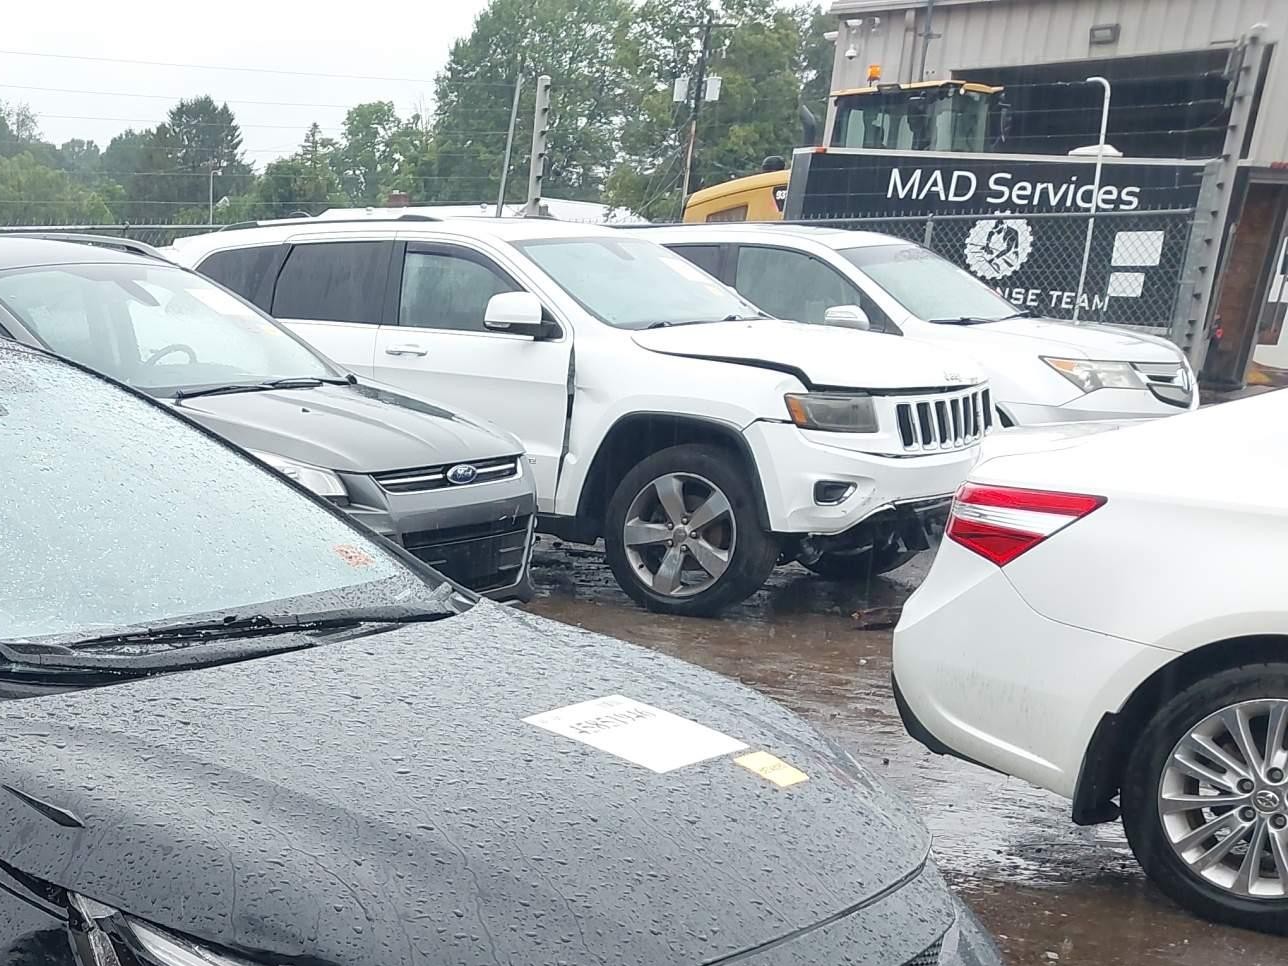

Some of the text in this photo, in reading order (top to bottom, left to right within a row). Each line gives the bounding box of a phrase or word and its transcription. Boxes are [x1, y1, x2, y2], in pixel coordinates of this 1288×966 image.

[886, 167, 1142, 211] MAD Services
[1048, 290, 1110, 312] TEAM
